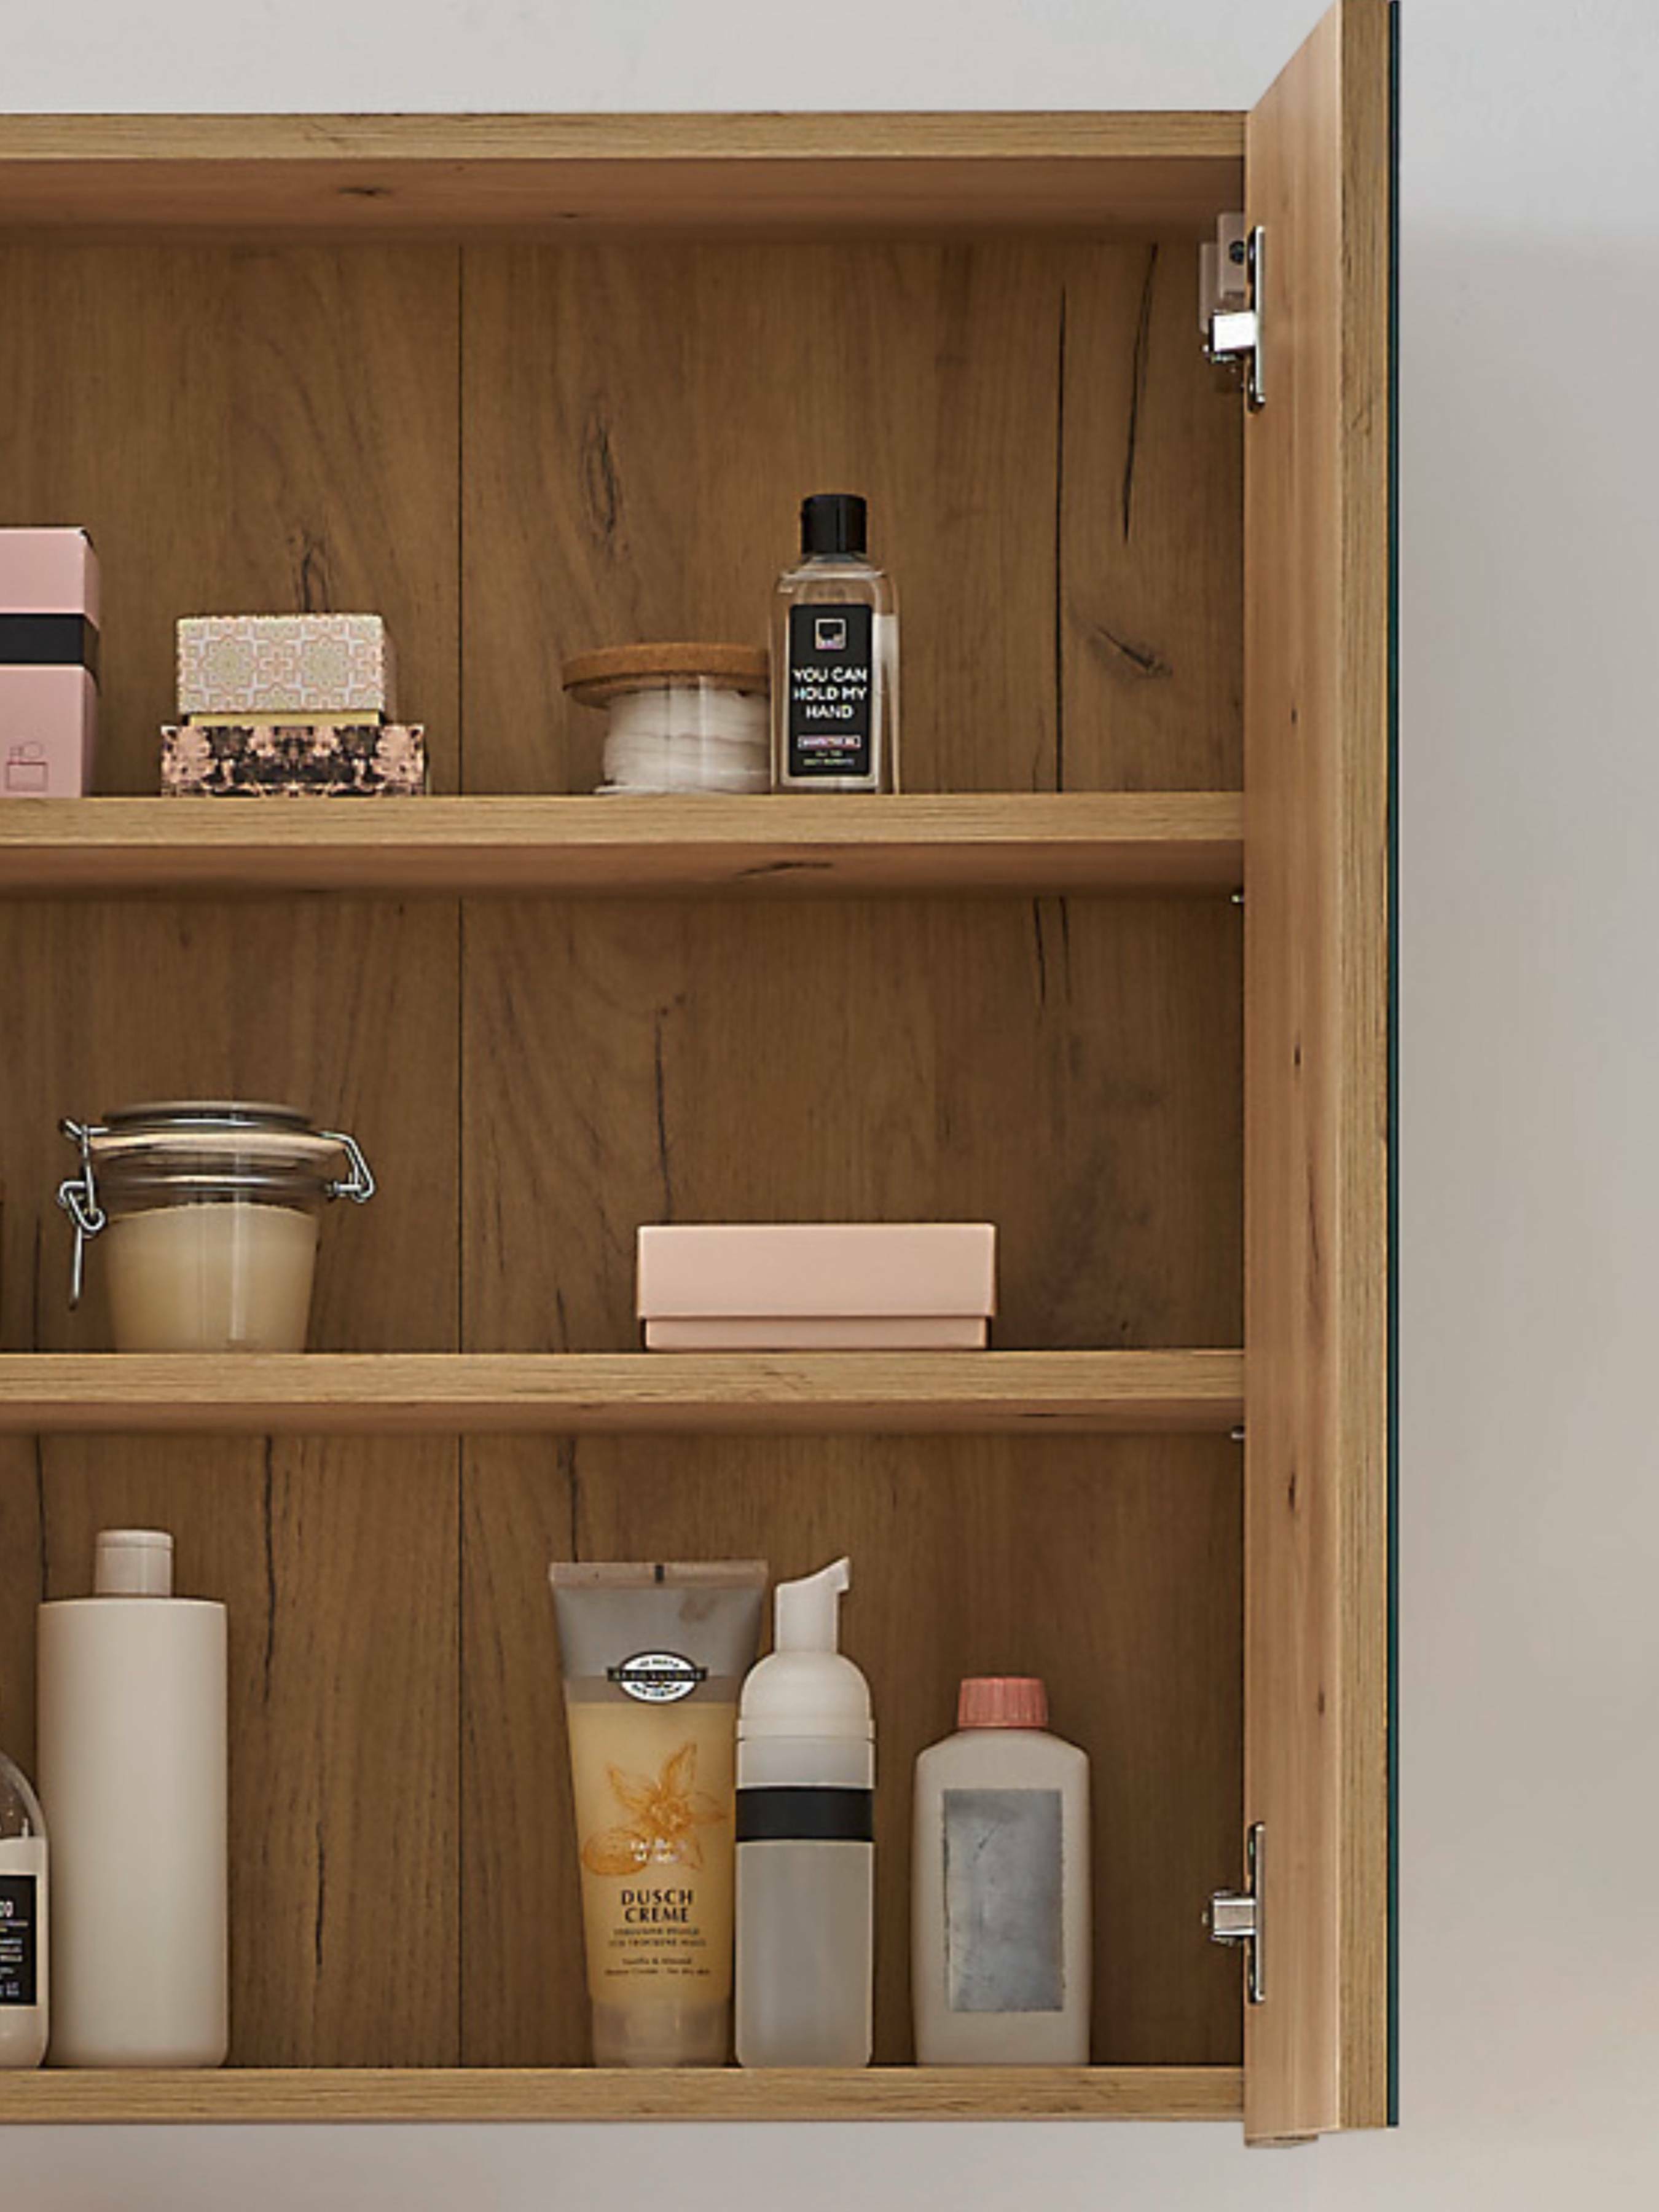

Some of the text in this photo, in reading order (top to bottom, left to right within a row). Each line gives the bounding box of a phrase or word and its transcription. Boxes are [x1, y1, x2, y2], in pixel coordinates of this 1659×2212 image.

[792, 667, 867, 683] YOU CAN
[793, 686, 867, 700] HOLD MY
[806, 704, 854, 719] HAND
[621, 1889, 693, 1905] DUSCH
[624, 1907, 689, 1923] CREME
